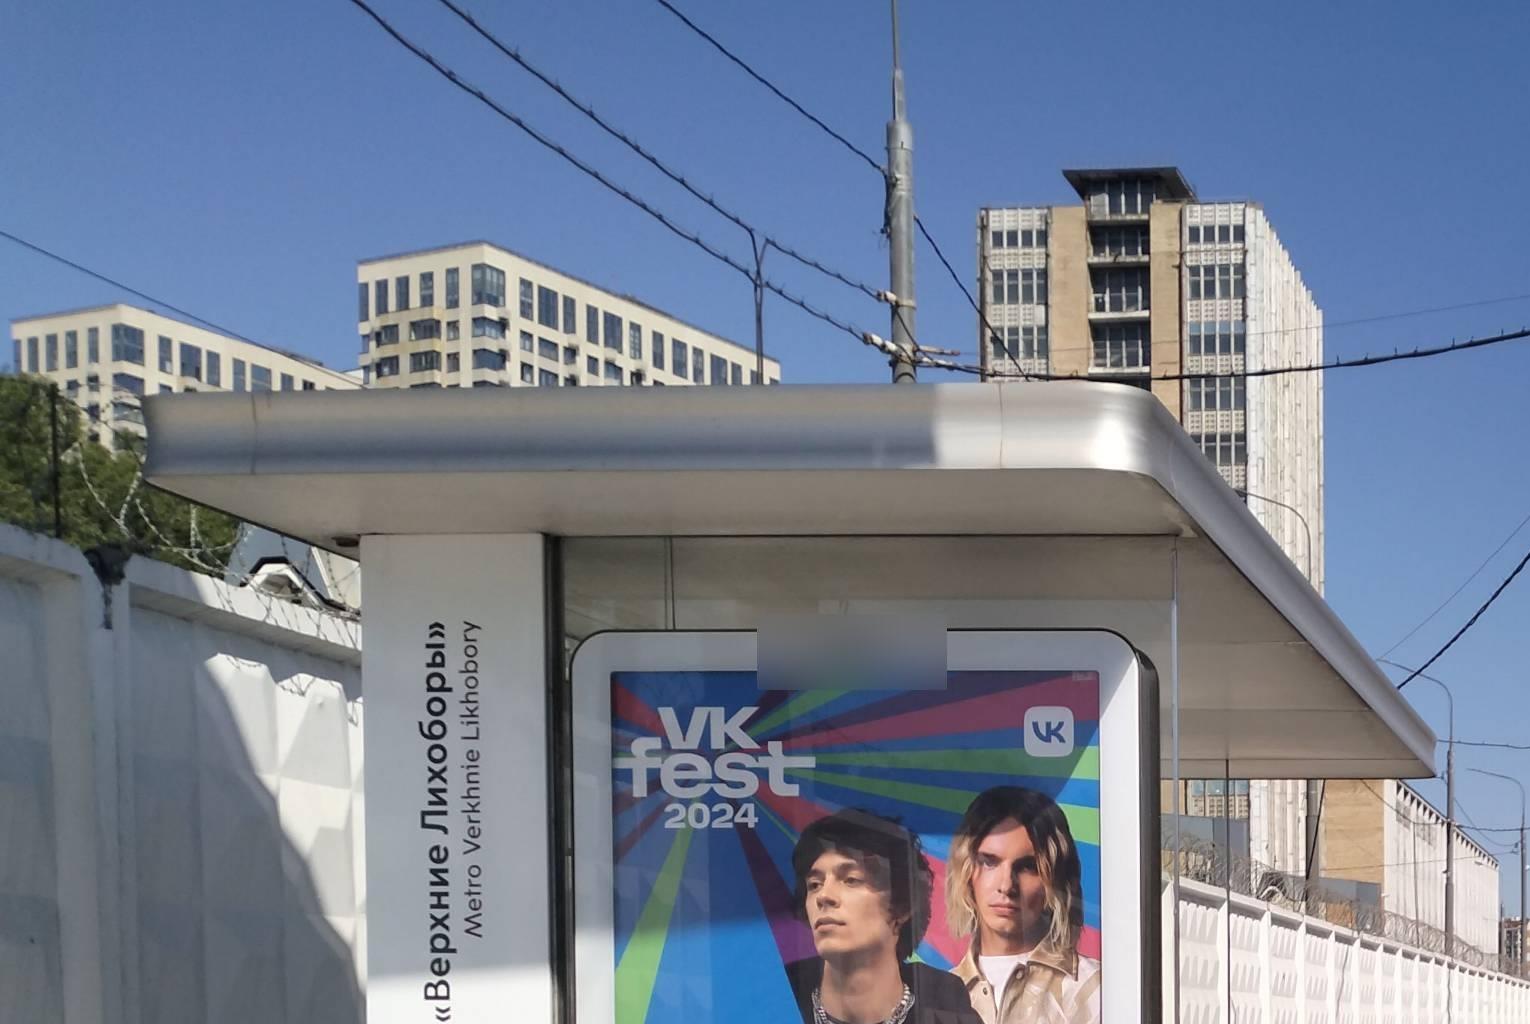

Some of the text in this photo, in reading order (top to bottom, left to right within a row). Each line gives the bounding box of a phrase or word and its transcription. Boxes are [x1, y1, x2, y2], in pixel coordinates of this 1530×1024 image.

[419, 620, 454, 835] Лихоборы»
[457, 620, 483, 939] Metro Verkhnie Likhobory
[613, 736, 816, 798] fest
[657, 706, 760, 749] VK
[663, 802, 759, 829] 2024
[423, 843, 458, 1024] «Верхние
